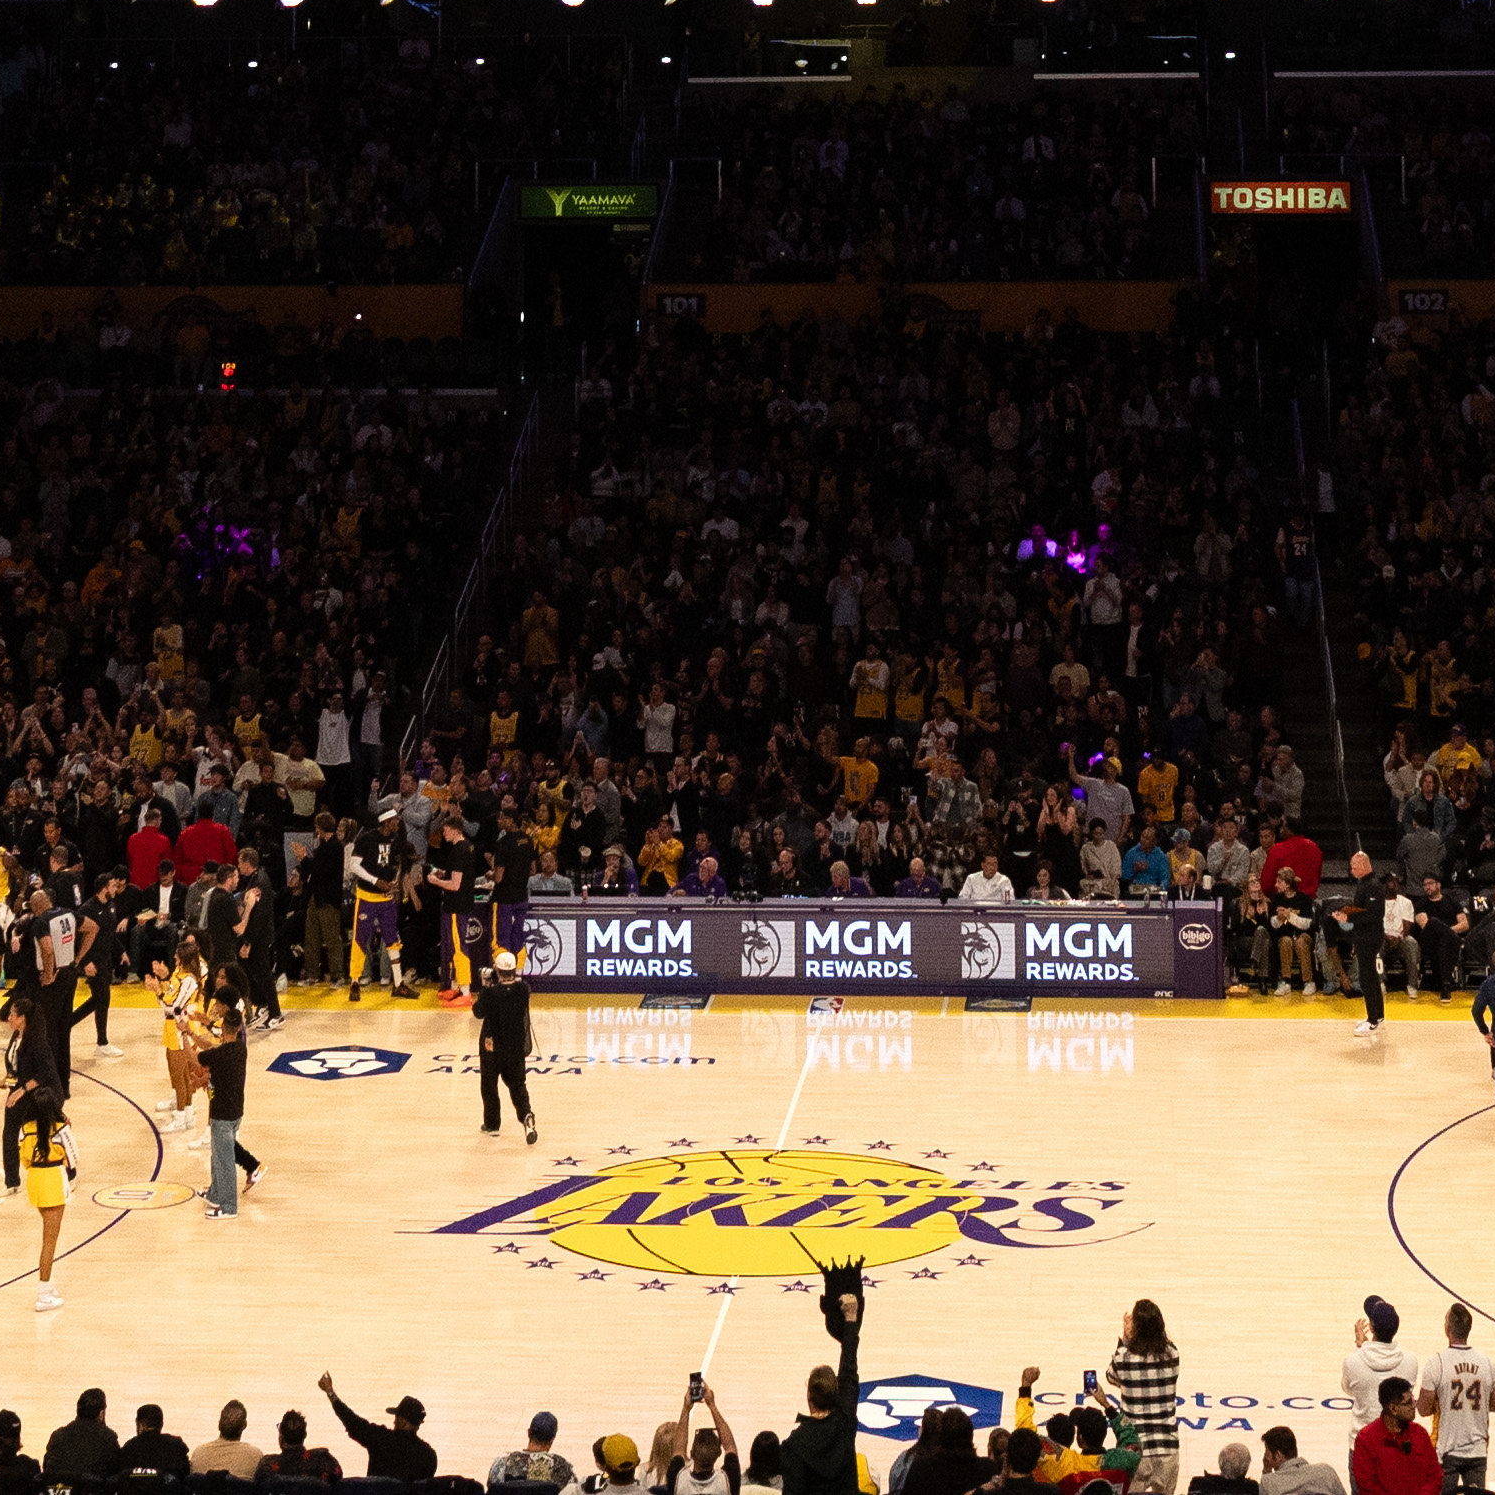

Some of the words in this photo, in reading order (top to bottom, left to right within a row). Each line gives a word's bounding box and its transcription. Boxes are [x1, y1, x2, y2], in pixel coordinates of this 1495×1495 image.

[1213, 185, 1349, 211] TOSHIBA
[585, 919, 693, 957] MGM
[805, 921, 912, 956] MGM
[1024, 923, 1133, 959] MGM
[1181, 929, 1211, 943] bibigo
[432, 1054, 716, 1066] crto.com
[660, 1176, 789, 1187] LOS
[806, 1177, 1131, 1192] ANGELES
[394, 1174, 1156, 1249] LAKERS
[1450, 1377, 1482, 1412] 24
